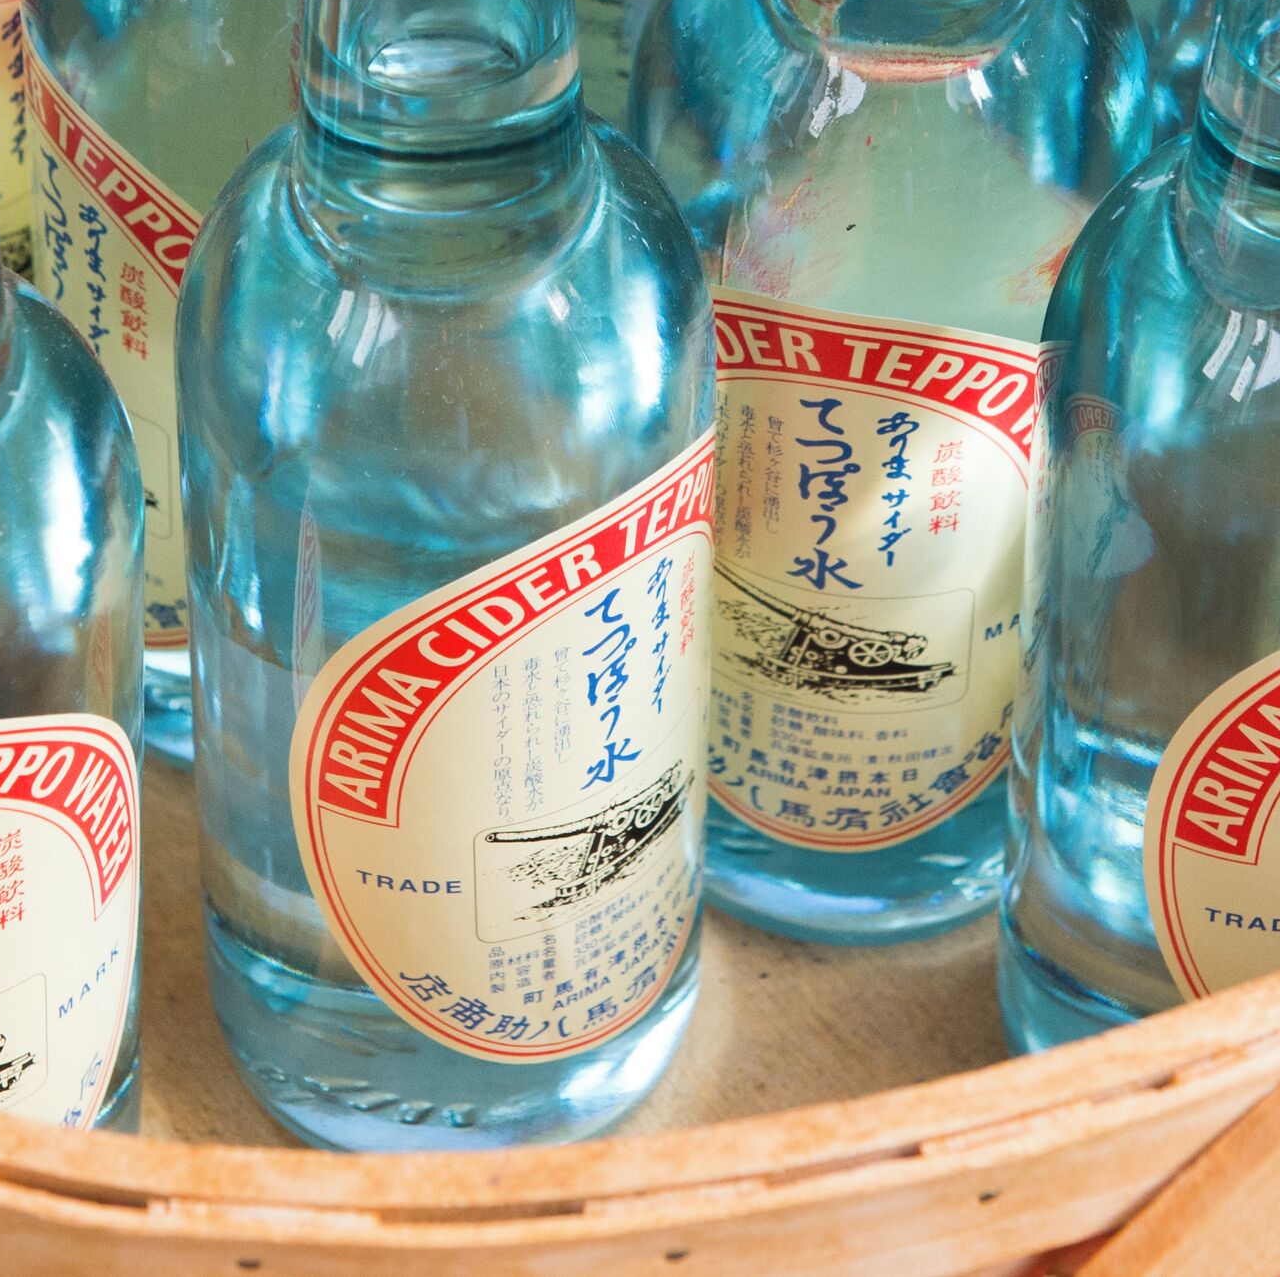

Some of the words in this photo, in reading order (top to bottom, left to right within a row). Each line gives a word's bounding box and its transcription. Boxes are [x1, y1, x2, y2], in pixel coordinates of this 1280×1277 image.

[53, 102, 196, 270] TEPPO
[842, 337, 1030, 417] TEPPO
[928, 440, 963, 536] 炭酸飲料
[325, 667, 439, 811] ARIMA
[418, 543, 607, 667] CIDER
[619, 457, 714, 560] TEPPO
[63, 752, 133, 893] WATER
[820, 779, 891, 799] JAPAN
[356, 869, 464, 895] TRADE
[552, 975, 611, 1012] ARIMA
